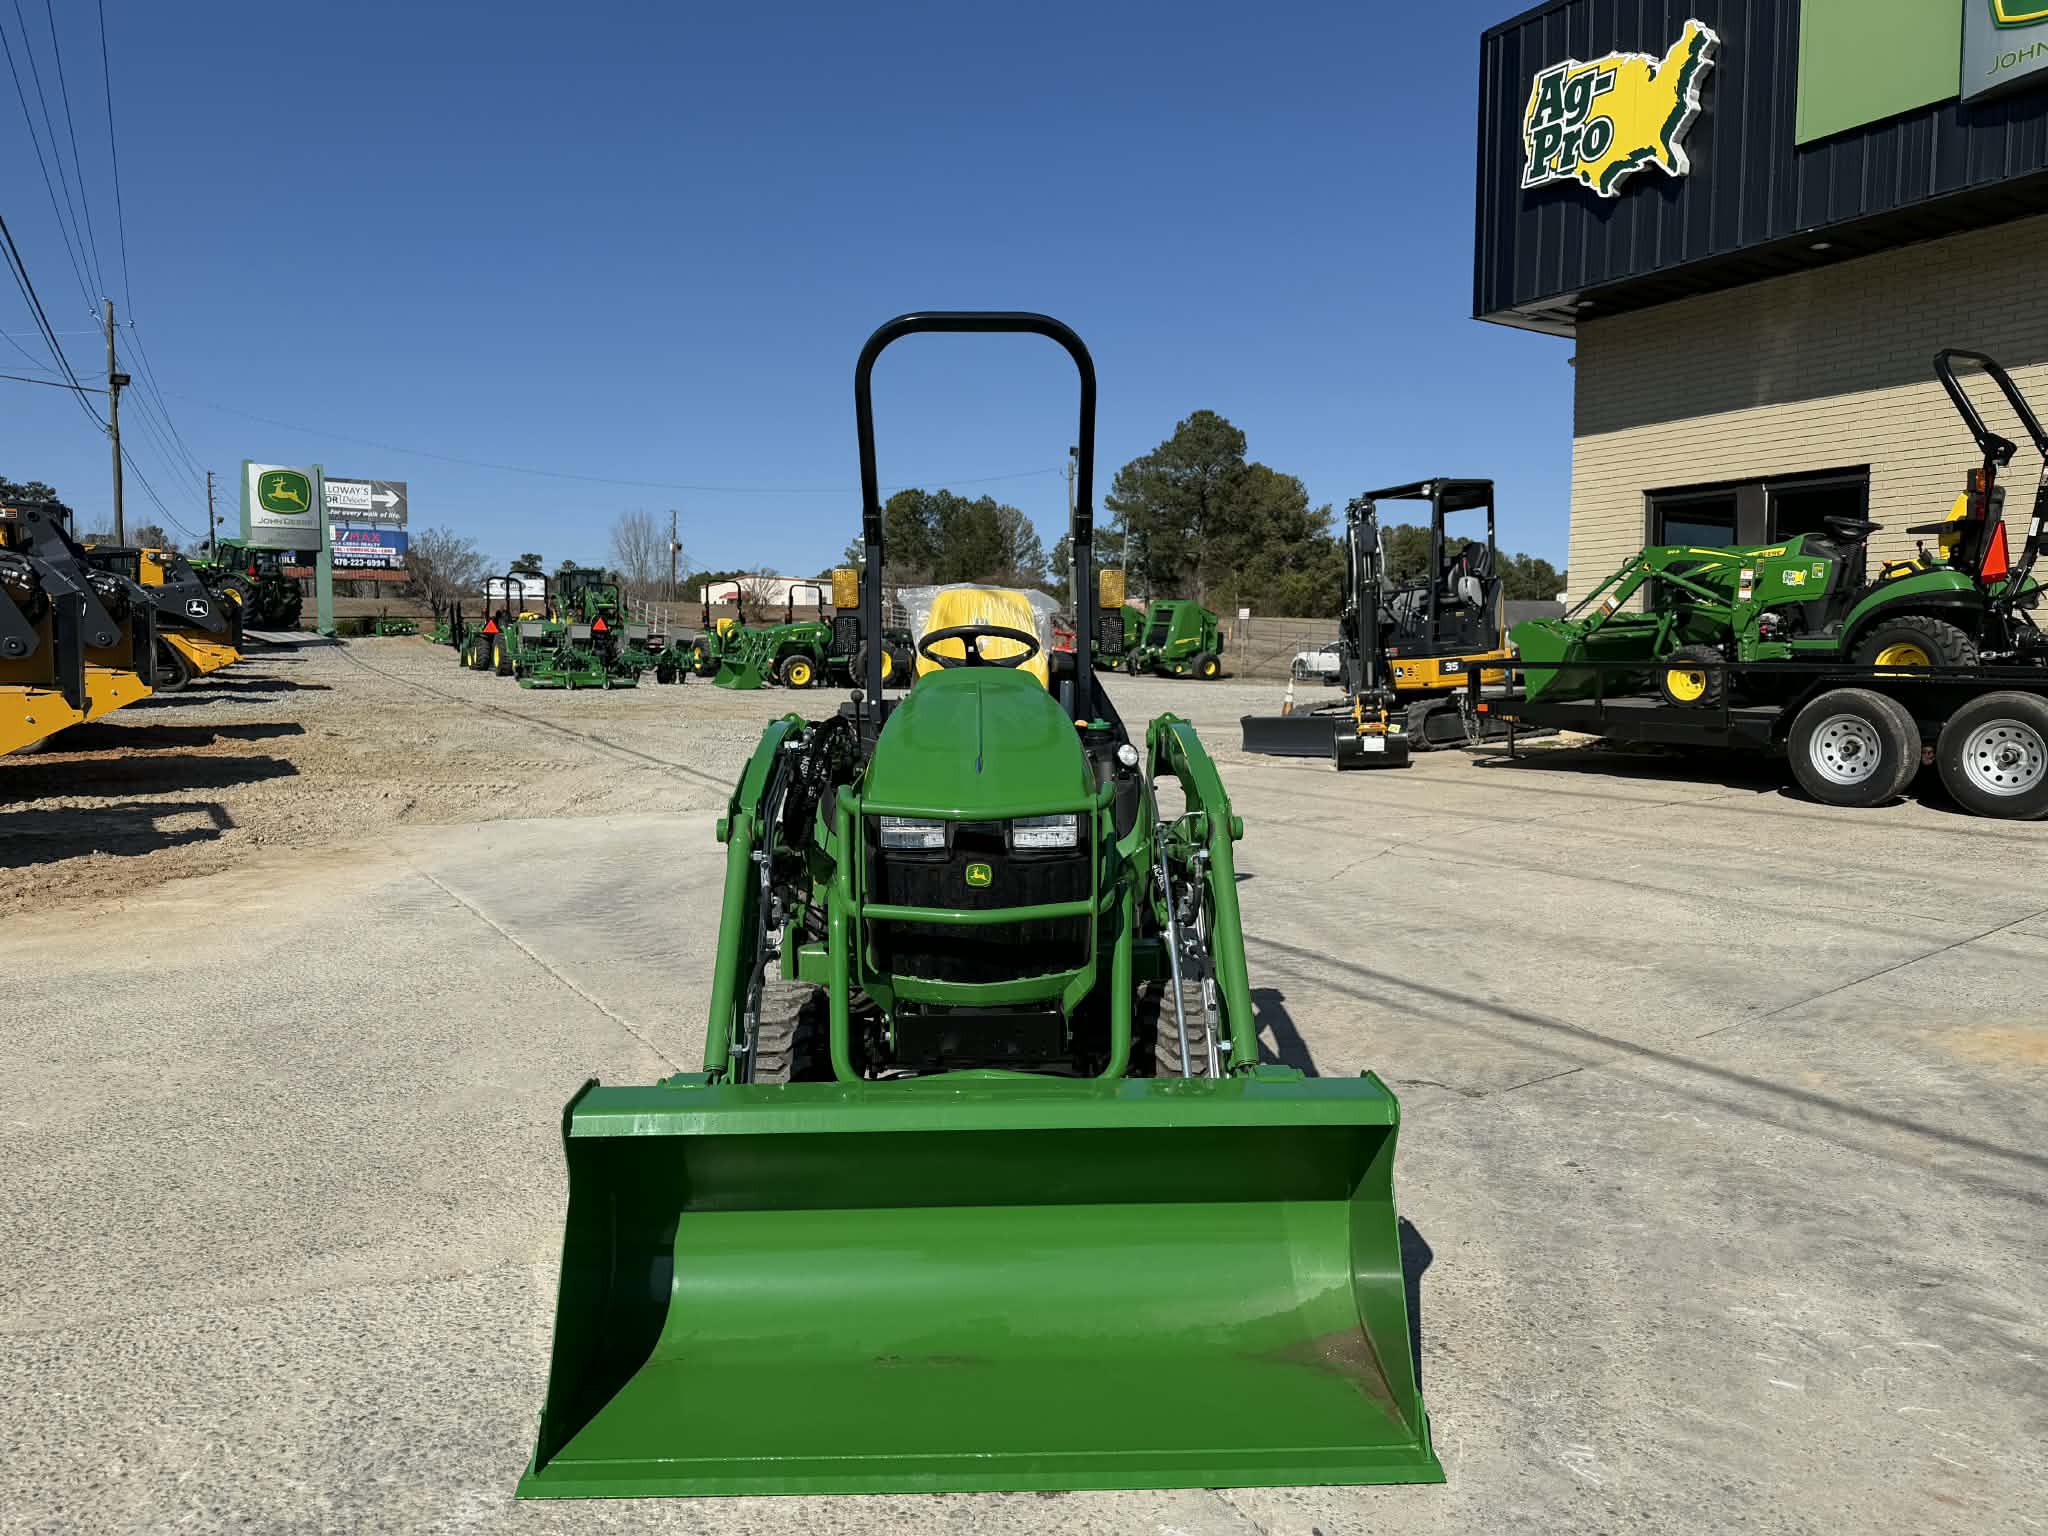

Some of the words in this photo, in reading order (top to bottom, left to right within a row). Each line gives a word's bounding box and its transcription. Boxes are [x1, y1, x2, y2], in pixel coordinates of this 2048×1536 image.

[1528, 67, 1615, 130] Ag-
[1526, 117, 1613, 181] Pro
[1445, 661, 1459, 672] 35
